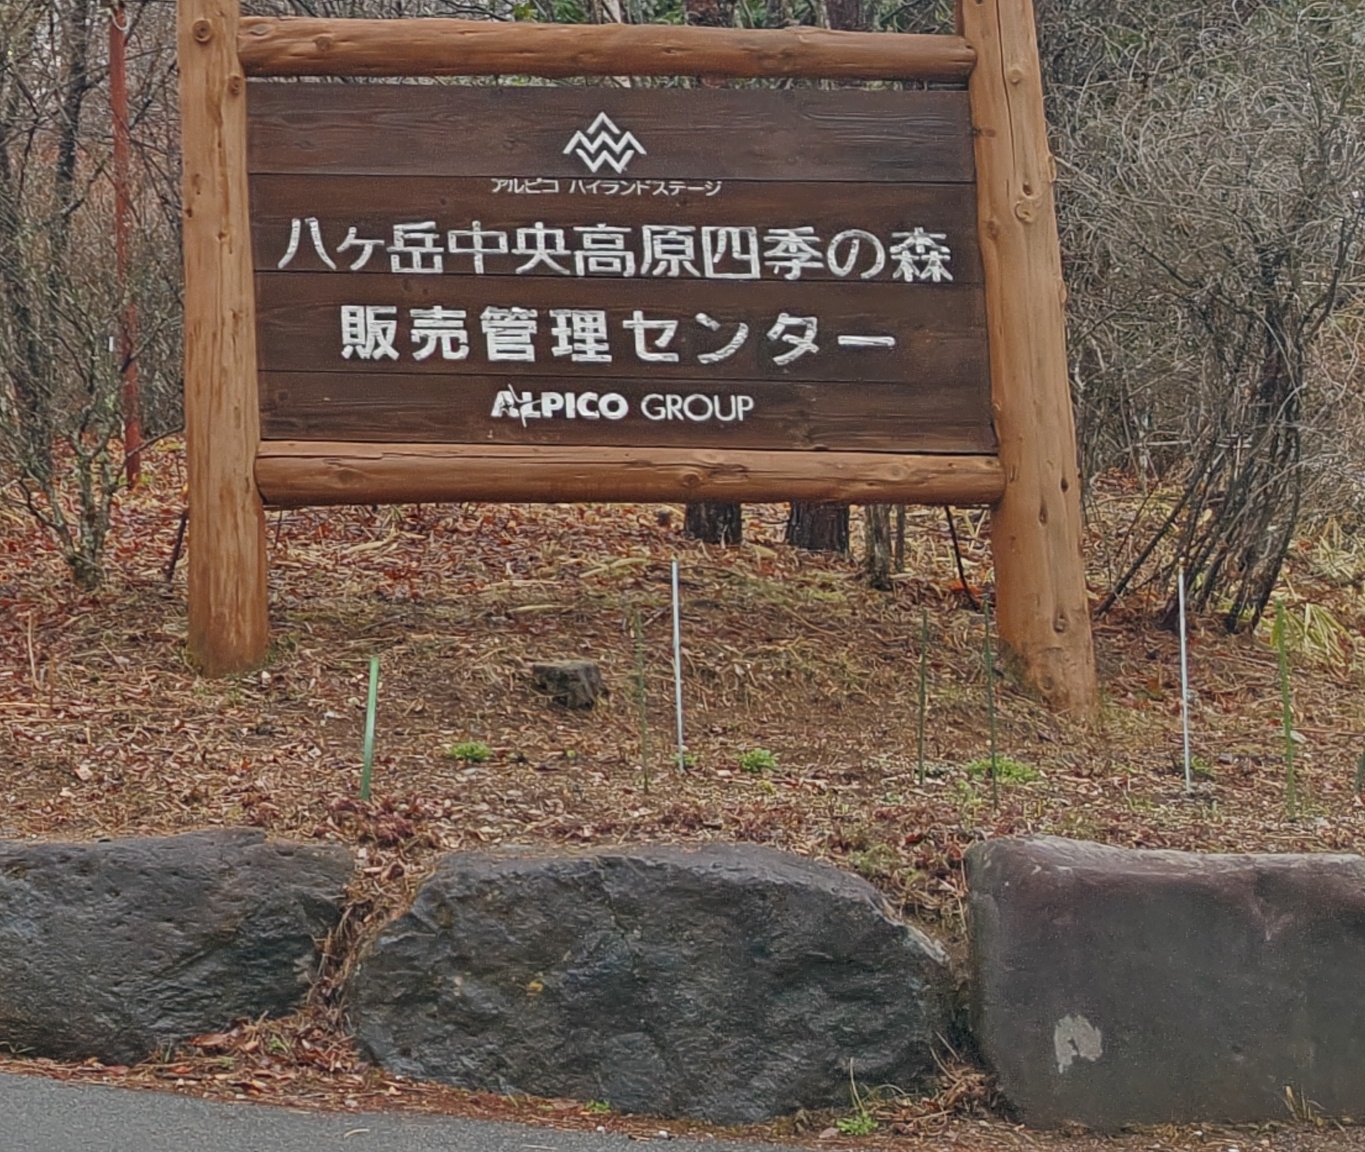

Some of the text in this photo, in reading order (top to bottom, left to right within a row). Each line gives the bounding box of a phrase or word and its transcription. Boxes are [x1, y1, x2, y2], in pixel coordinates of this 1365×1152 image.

[491, 177, 723, 196] アルピコ ハイランドステージ
[277, 217, 954, 283] 八ヶ岳中央高原四季の森
[340, 305, 897, 366] 販売管理センター
[490, 384, 755, 427] ALPICO GROUP
